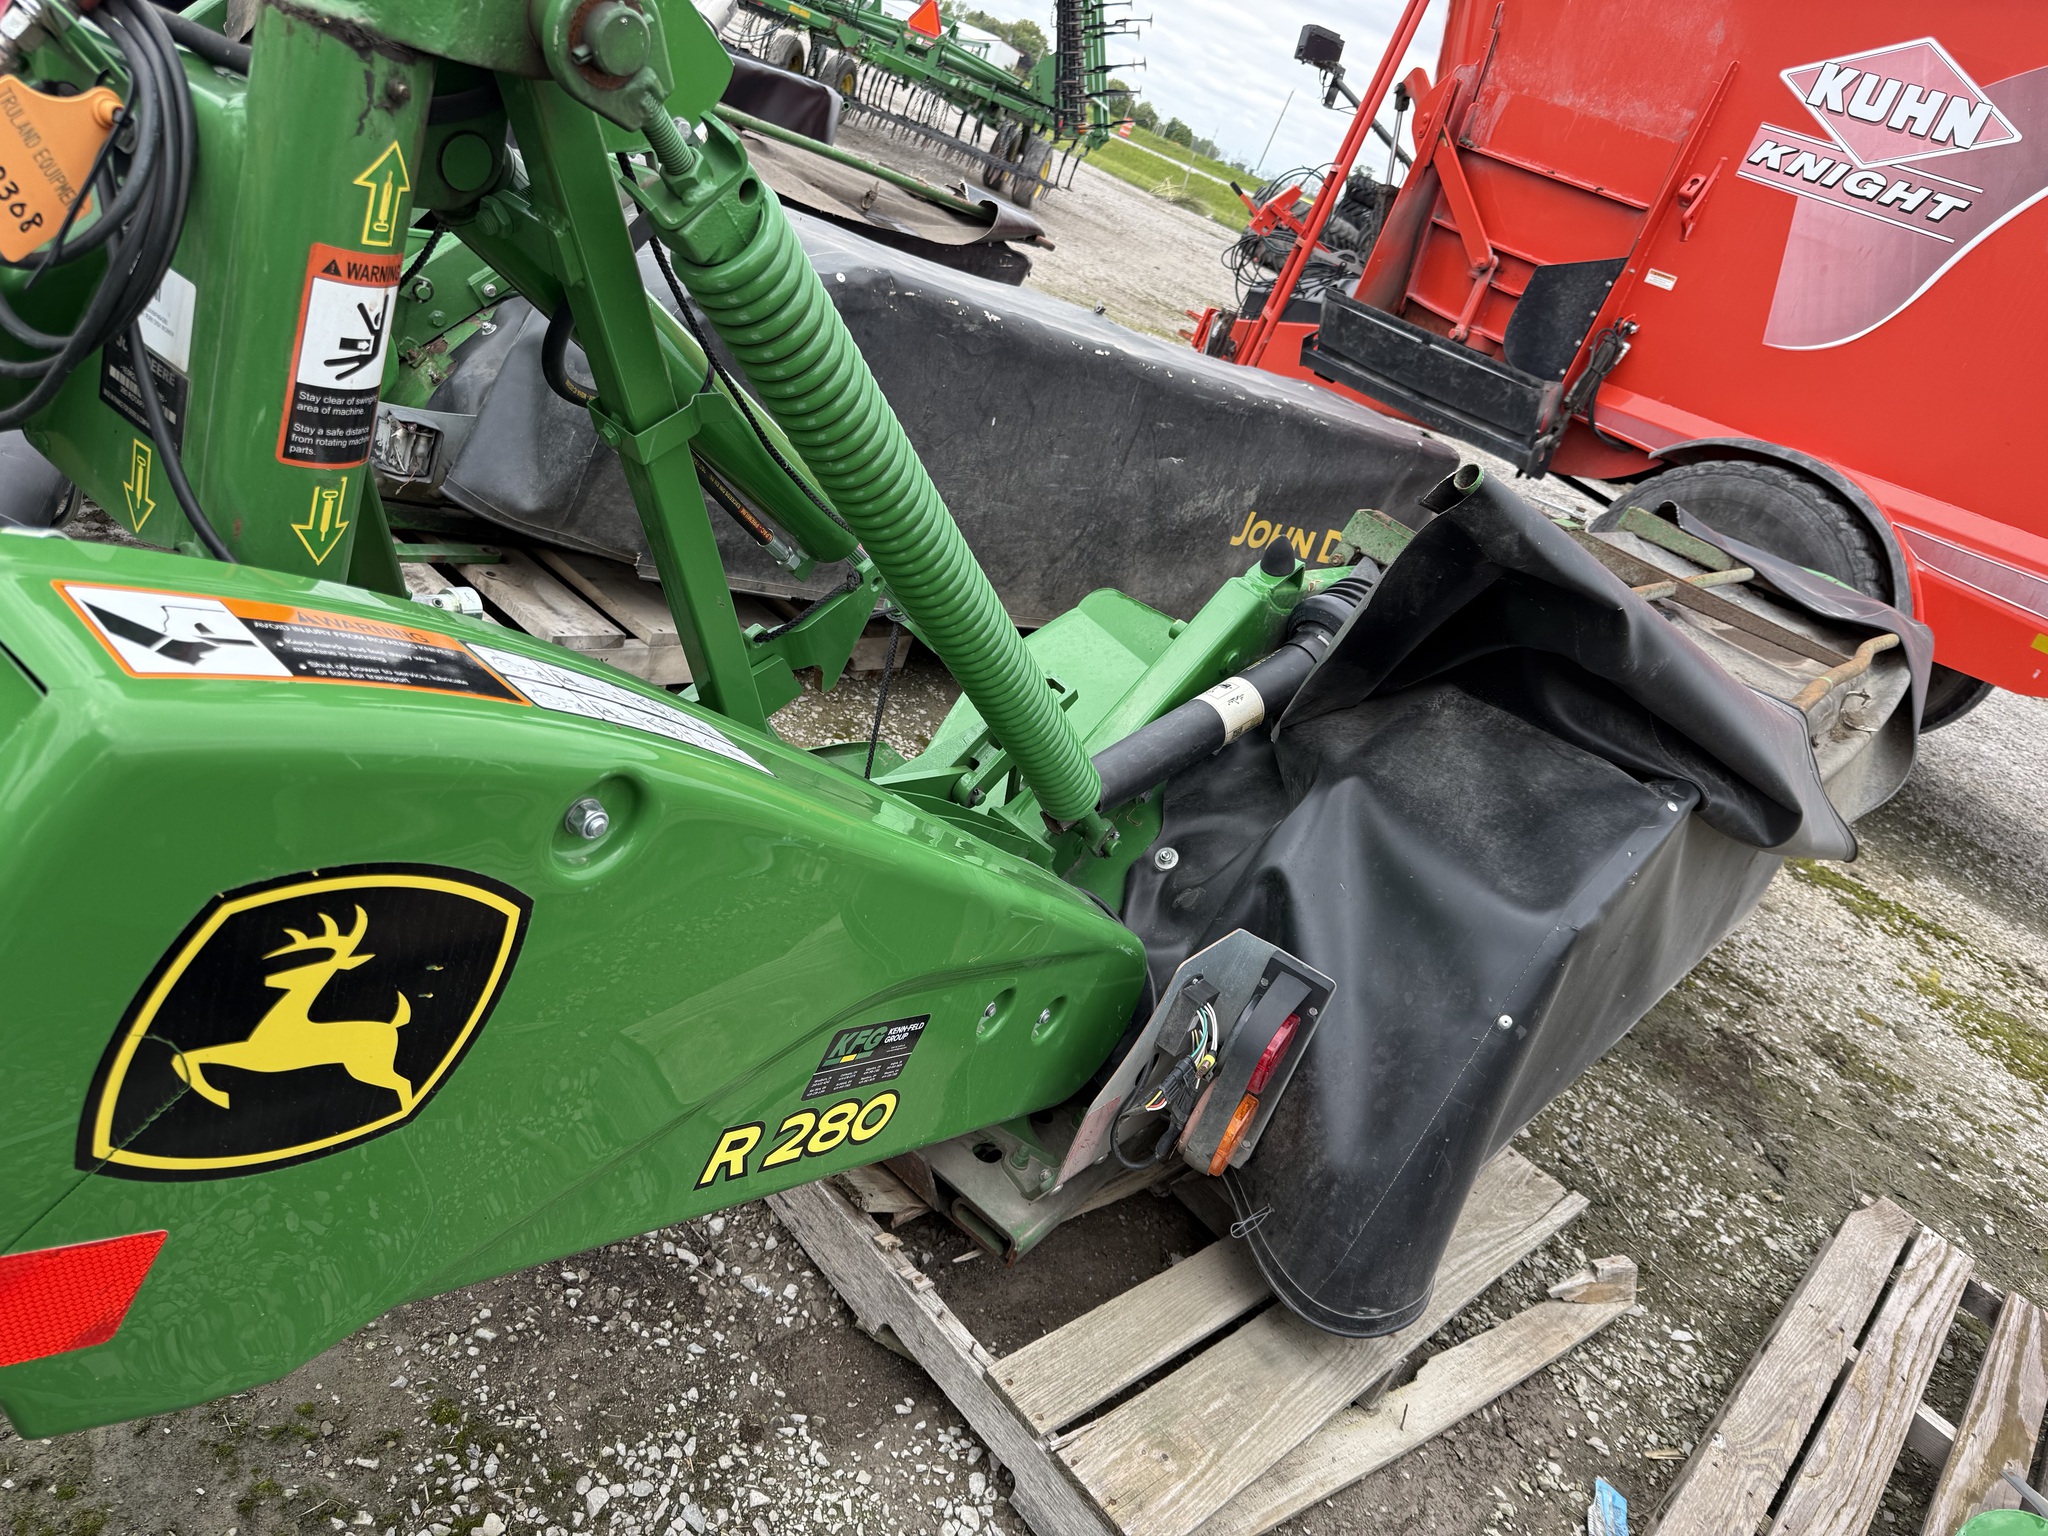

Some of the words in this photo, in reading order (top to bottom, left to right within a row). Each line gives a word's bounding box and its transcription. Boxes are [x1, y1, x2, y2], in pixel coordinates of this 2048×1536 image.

[1806, 61, 1993, 150] KUHN
[1747, 139, 1973, 222] KNIGHT
[298, 391, 321, 402] Stay
[323, 396, 345, 406] clear
[346, 397, 355, 405] of
[296, 403, 319, 414] area
[321, 406, 331, 415] of
[332, 407, 365, 416] machine.
[293, 423, 316, 435] Stay
[326, 427, 344, 437] safe
[291, 433, 313, 444] from
[315, 439, 347, 448] rotating
[289, 445, 316, 456] parts.
[315, 615, 430, 643] WARNING
[828, 1025, 889, 1059] KFG
[888, 1021, 925, 1035] KENN-FELD
[884, 1032, 909, 1044] GROUP
[694, 1121, 765, 1190] R
[758, 1090, 900, 1173] 280
